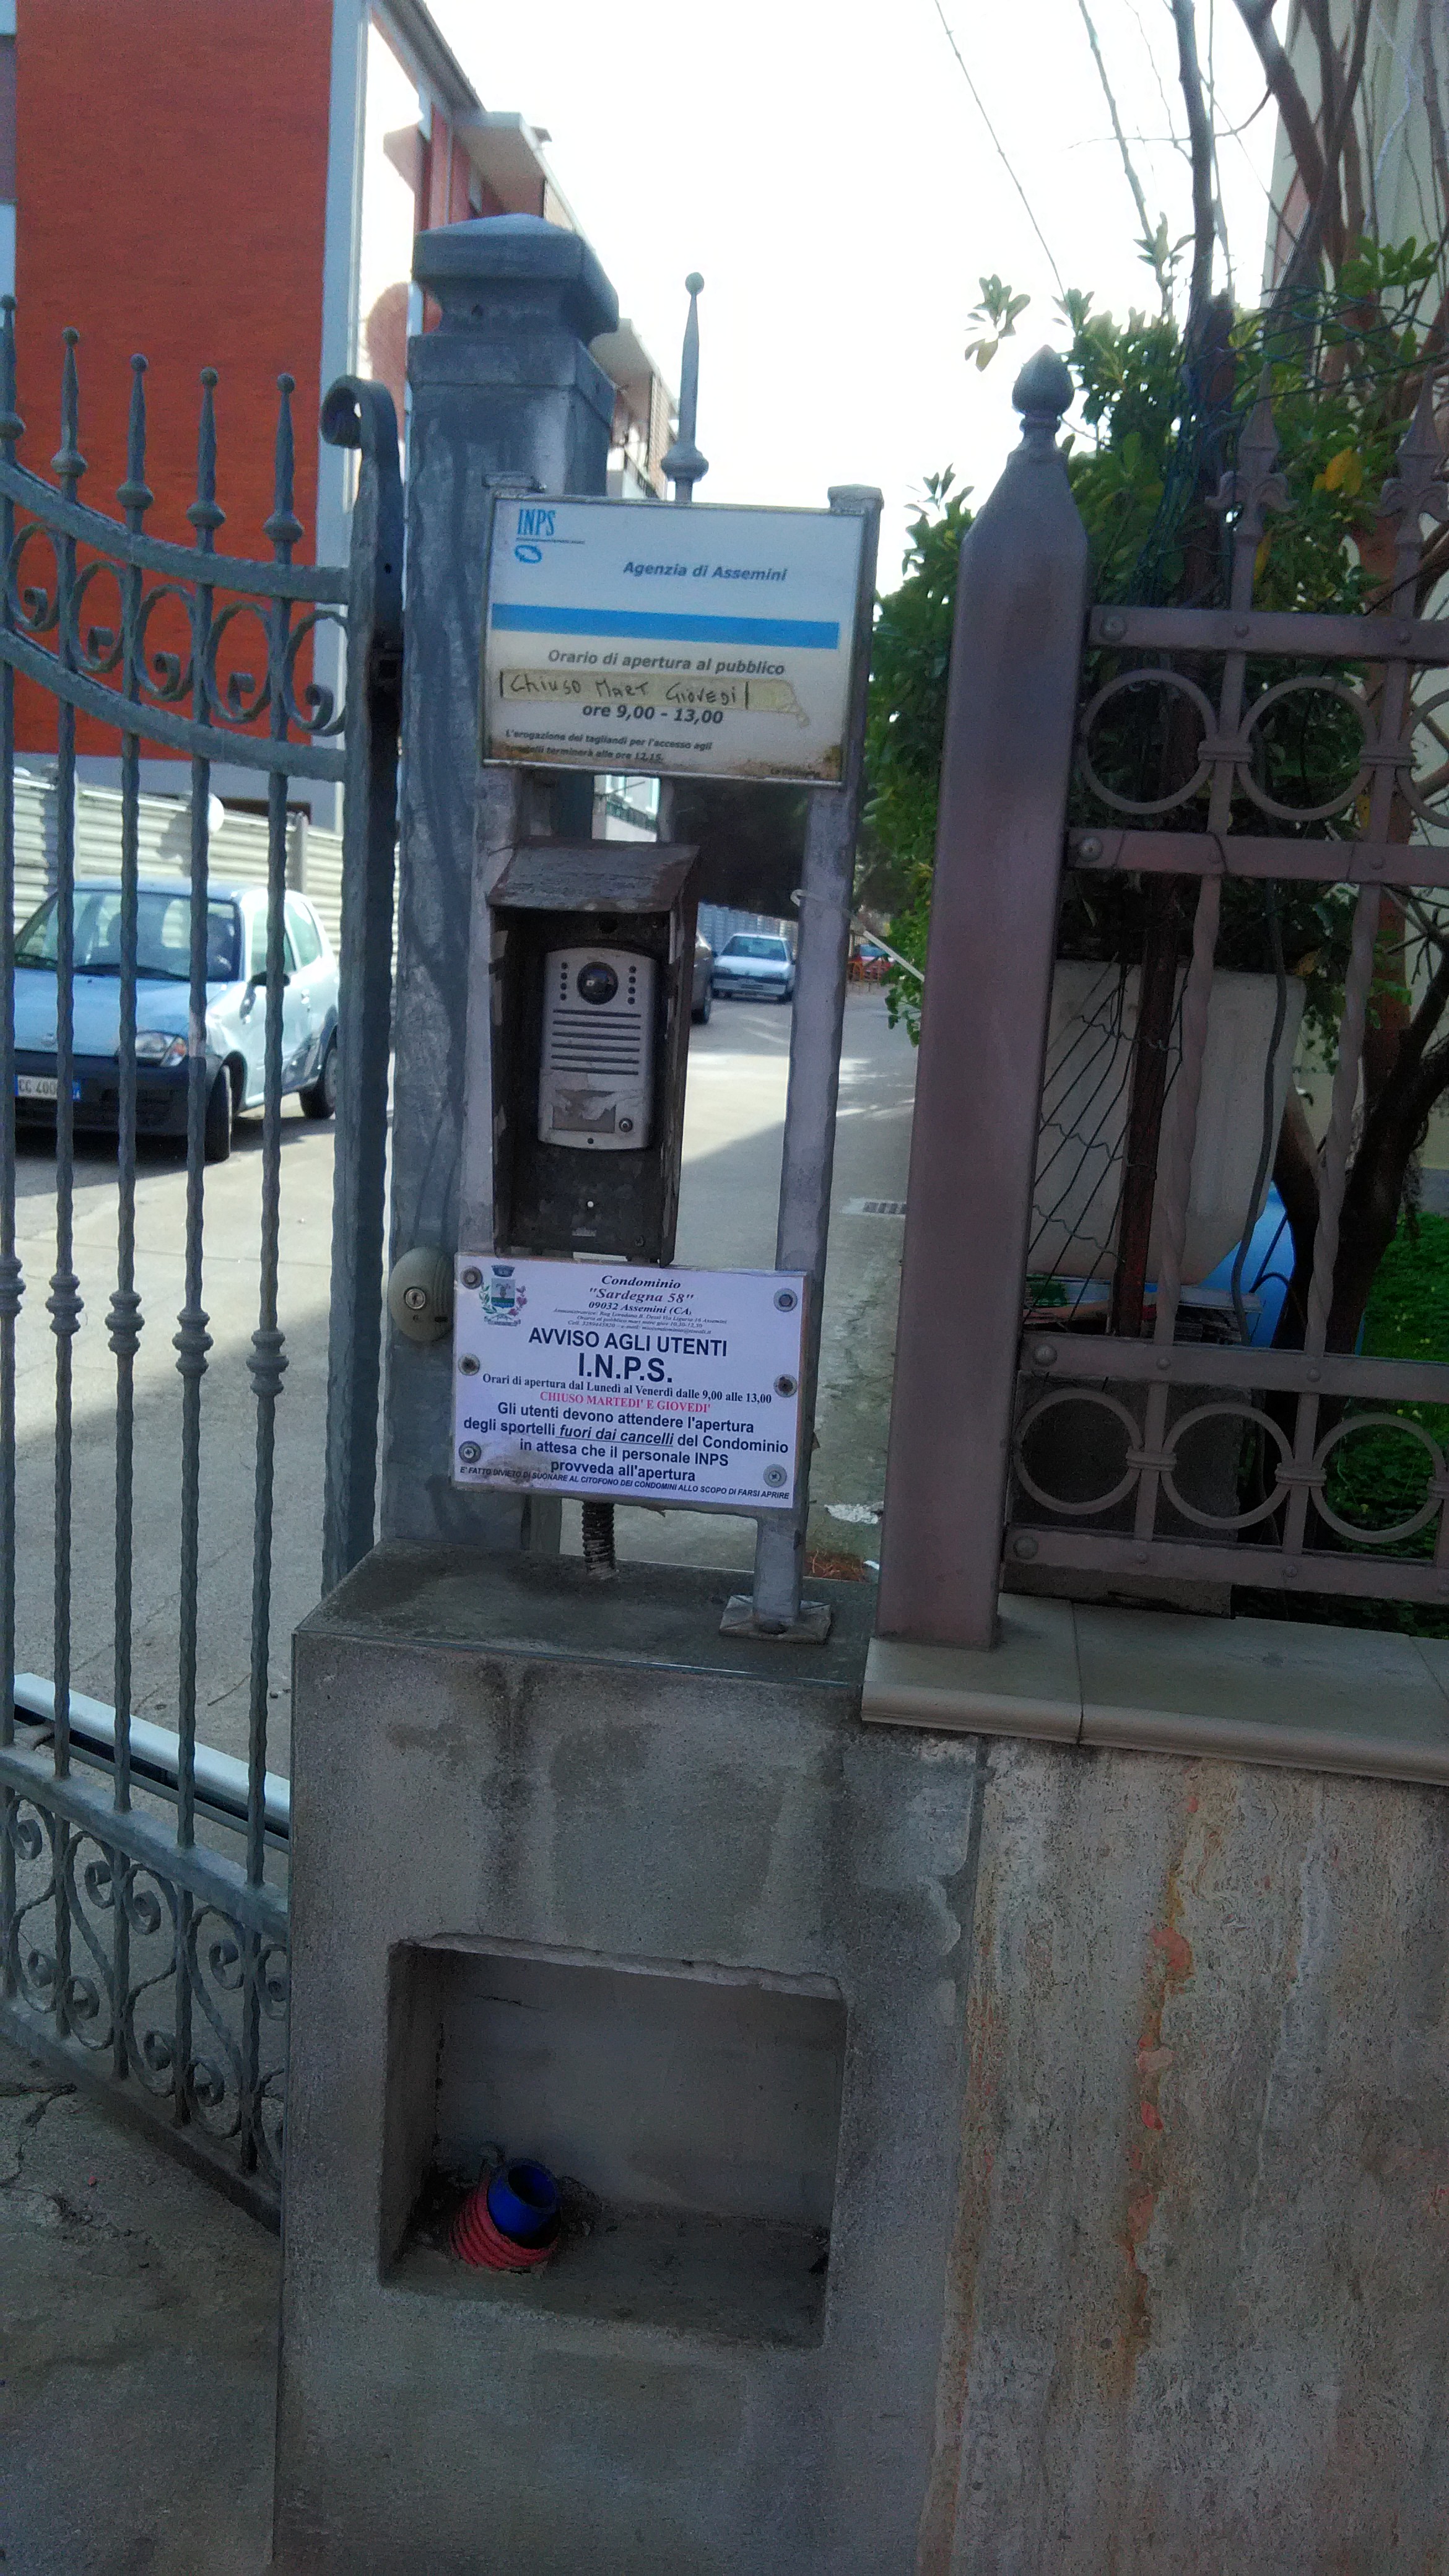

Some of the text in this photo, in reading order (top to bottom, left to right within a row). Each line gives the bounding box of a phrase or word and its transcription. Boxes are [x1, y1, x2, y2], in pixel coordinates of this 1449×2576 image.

[516, 508, 556, 536] INPS
[623, 562, 788, 581] Agenzia di Assemini
[548, 649, 785, 675] Orario di apertura al pubblico
[582, 705, 611, 717] ore
[616, 704, 655, 721] 9,00
[674, 708, 724, 725] 13,00
[585, 735, 627, 744] tagliandi
[629, 738, 646, 747] per
[601, 1274, 681, 1289] Condominio
[588, 1301, 619, 1310] 09032
[620, 1303, 667, 1313] Assemini
[589, 1287, 694, 1303] "Sardegna 58"
[528, 1327, 727, 1357] AVVISO AGLI UTENTI
[578, 1352, 672, 1383] I.N.P.S.
[482, 1373, 772, 1404] Orari di apertura dal Lunedì al Venerdì dalle 9,00 alle 13,00
[540, 1391, 711, 1413] CHIUSO MARTEDI' E GIOVEDI'
[498, 1401, 754, 1434] Gli utenti devono attendere l'apertura
[464, 1416, 789, 1454] degli sportelli fuori dai cancelli del Condominio
[520, 1438, 729, 1466] in attesa che il personale INPS
[469, 1467, 491, 1475] FATTO
[493, 1469, 521, 1477] DIVIETO
[532, 1471, 568, 1482] SUONARE
[569, 1475, 578, 1483] AL
[581, 1476, 619, 1486] CITOFONO
[620, 1479, 633, 1487] DEI
[634, 1480, 677, 1491] CONDOMINI
[678, 1484, 698, 1492] ALLO
[700, 1486, 727, 1495] SCOPO
[738, 1489, 760, 1497] FARSI
[760, 1490, 790, 1499] APRIRE
[551, 1460, 695, 1482] provveda all'apertura
